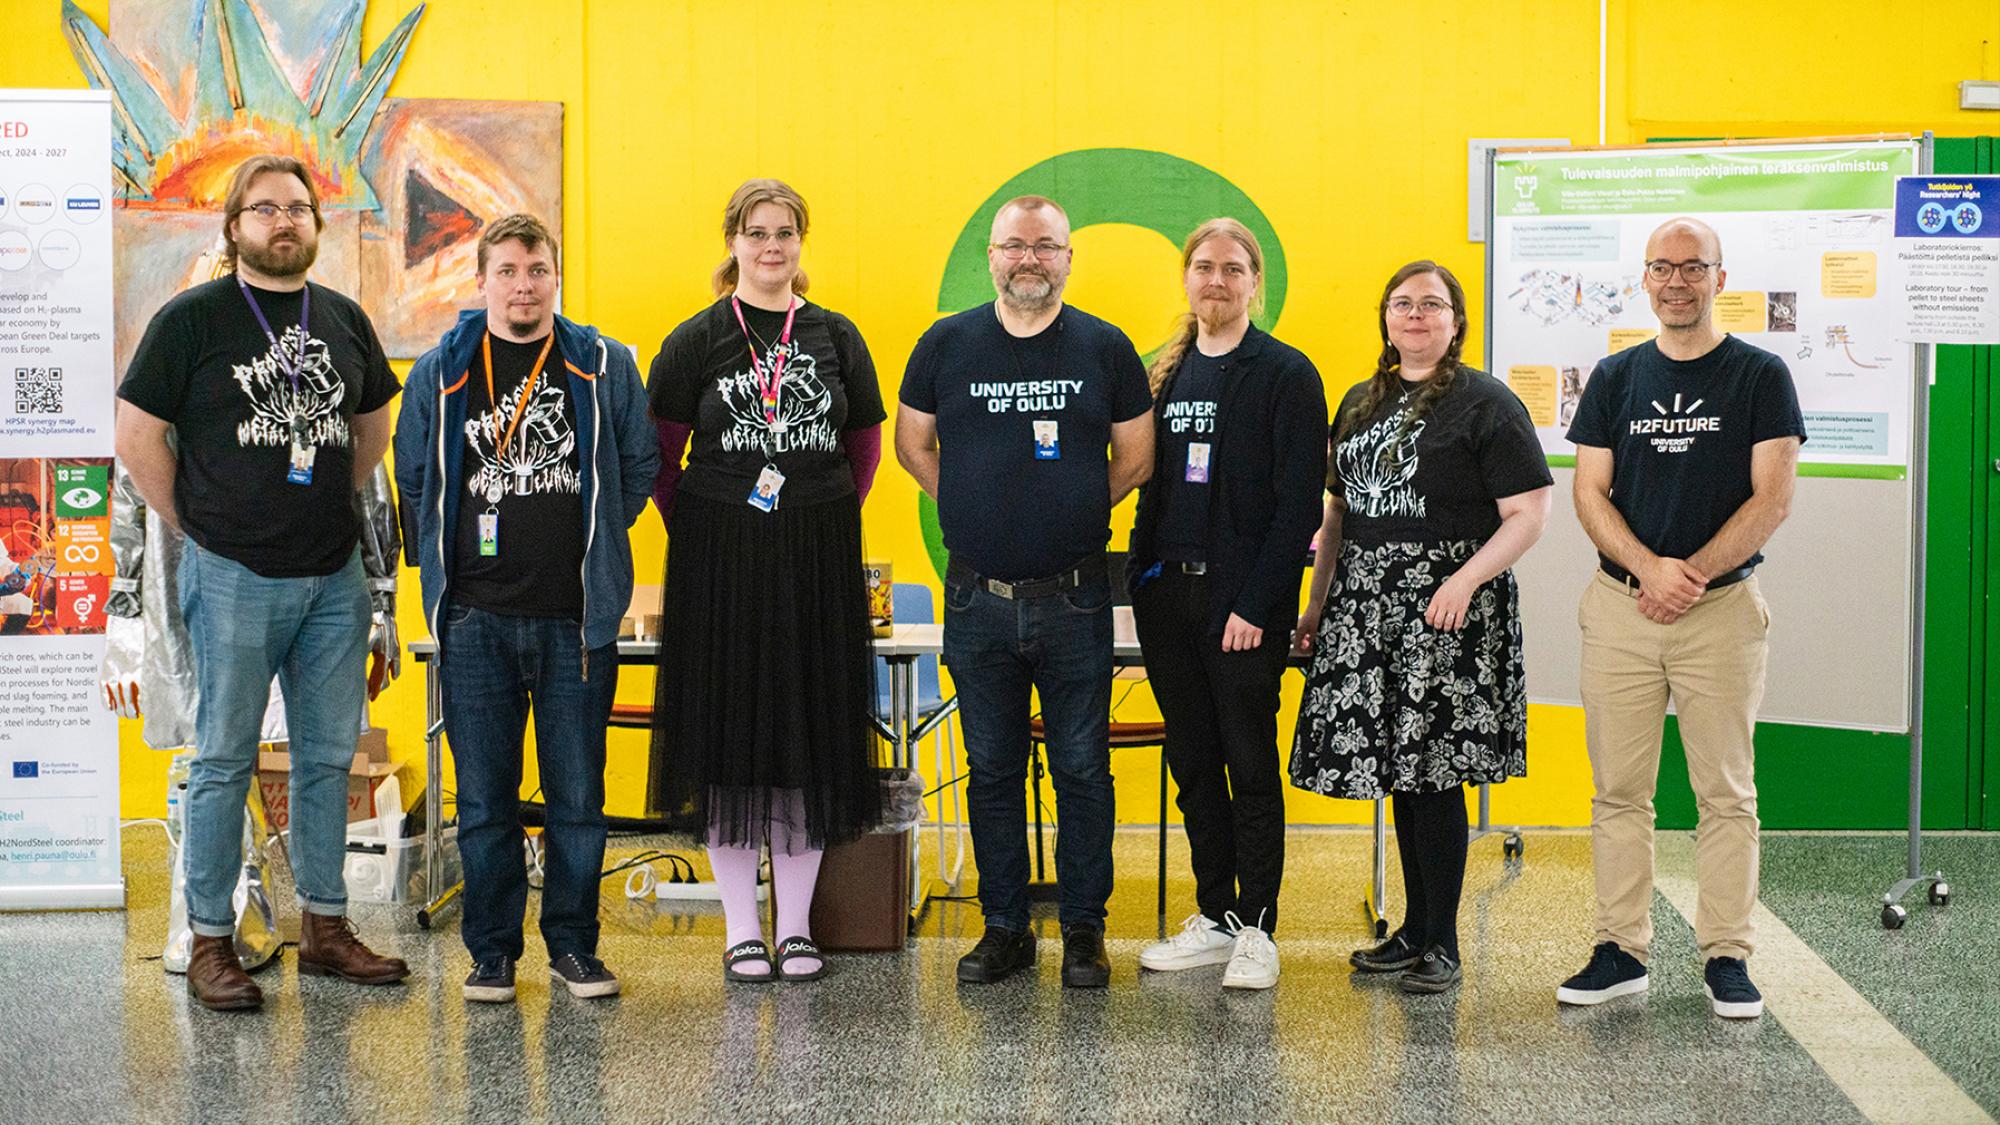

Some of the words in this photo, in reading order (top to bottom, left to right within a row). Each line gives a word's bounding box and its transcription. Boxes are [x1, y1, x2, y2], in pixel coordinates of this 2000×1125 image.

[0, 121, 29, 138] ED
[15, 148, 37, 157] 2024
[46, 148, 67, 157] 2027
[1905, 285, 1945, 294] Laboratory
[1970, 285, 1989, 293] from
[31, 291, 48, 301] and
[9, 321, 48, 330] economy
[49, 319, 61, 329] by
[21, 331, 47, 341] Green
[49, 331, 69, 341] Deal
[71, 332, 101, 343] targets
[20, 345, 53, 355] Europe.
[970, 379, 1084, 398] UNIVERSITY
[987, 398, 1012, 413] OF
[1016, 394, 1066, 412] OULU
[27, 418, 58, 427] synergy
[58, 418, 77, 426] map
[1170, 417, 1192, 433] OF
[1629, 417, 1721, 435] H2FUTURE
[1650, 436, 1696, 446] UNIVERSITY
[57, 469, 69, 482] 13
[58, 525, 69, 537] 12
[59, 580, 66, 592] 5
[16, 653, 37, 662] ores,
[39, 652, 63, 661] which
[65, 652, 81, 661] can
[82, 652, 94, 661] be
[25, 665, 39, 674] will
[41, 665, 73, 676] explore
[74, 664, 98, 674] novel
[9, 680, 50, 690] processes
[51, 678, 64, 687] for
[66, 678, 95, 687] Nordic
[13, 692, 30, 702] slag
[32, 691, 70, 702] foaming,
[72, 691, 88, 700] and
[50, 704, 64, 713] The
[67, 703, 89, 713] main
[4, 718, 24, 728] steel
[26, 718, 60, 729] industry
[62, 718, 78, 726] can
[80, 717, 91, 726] be
[55, 837, 107, 847] coordinator:
[730, 946, 765, 960] jalas
[783, 942, 818, 956] jalas
